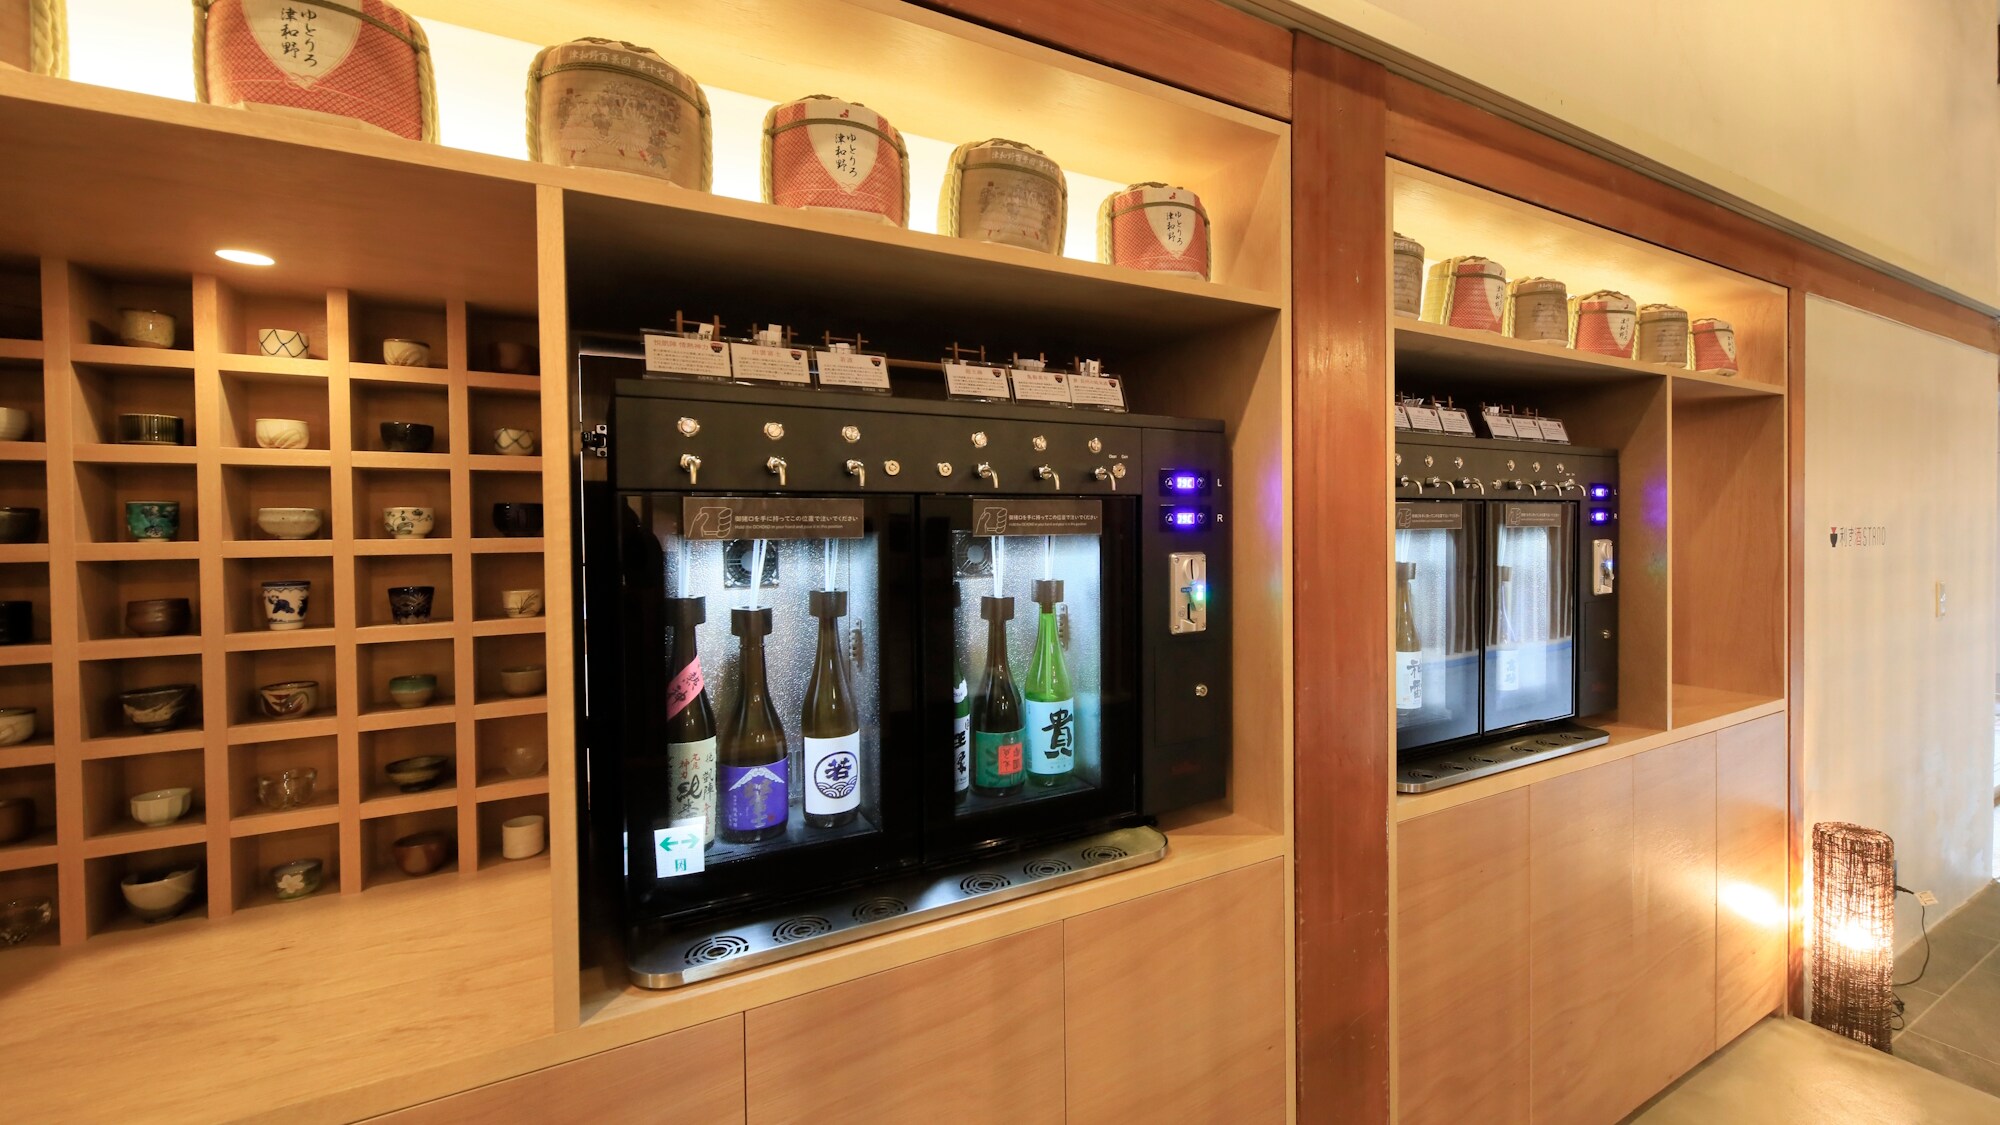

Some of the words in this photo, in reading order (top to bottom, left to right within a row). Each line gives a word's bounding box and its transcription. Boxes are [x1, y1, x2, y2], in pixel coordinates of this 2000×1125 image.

[280, 7, 300, 59] 津和野
[300, 9, 318, 67] ゆとりろ
[835, 132, 848, 172] 津和野
[846, 132, 858, 178] ゆとりろ
[1217, 478, 1222, 487] L
[1216, 514, 1223, 522] R
[1041, 708, 1073, 760] 貴
[825, 757, 852, 782] 若
